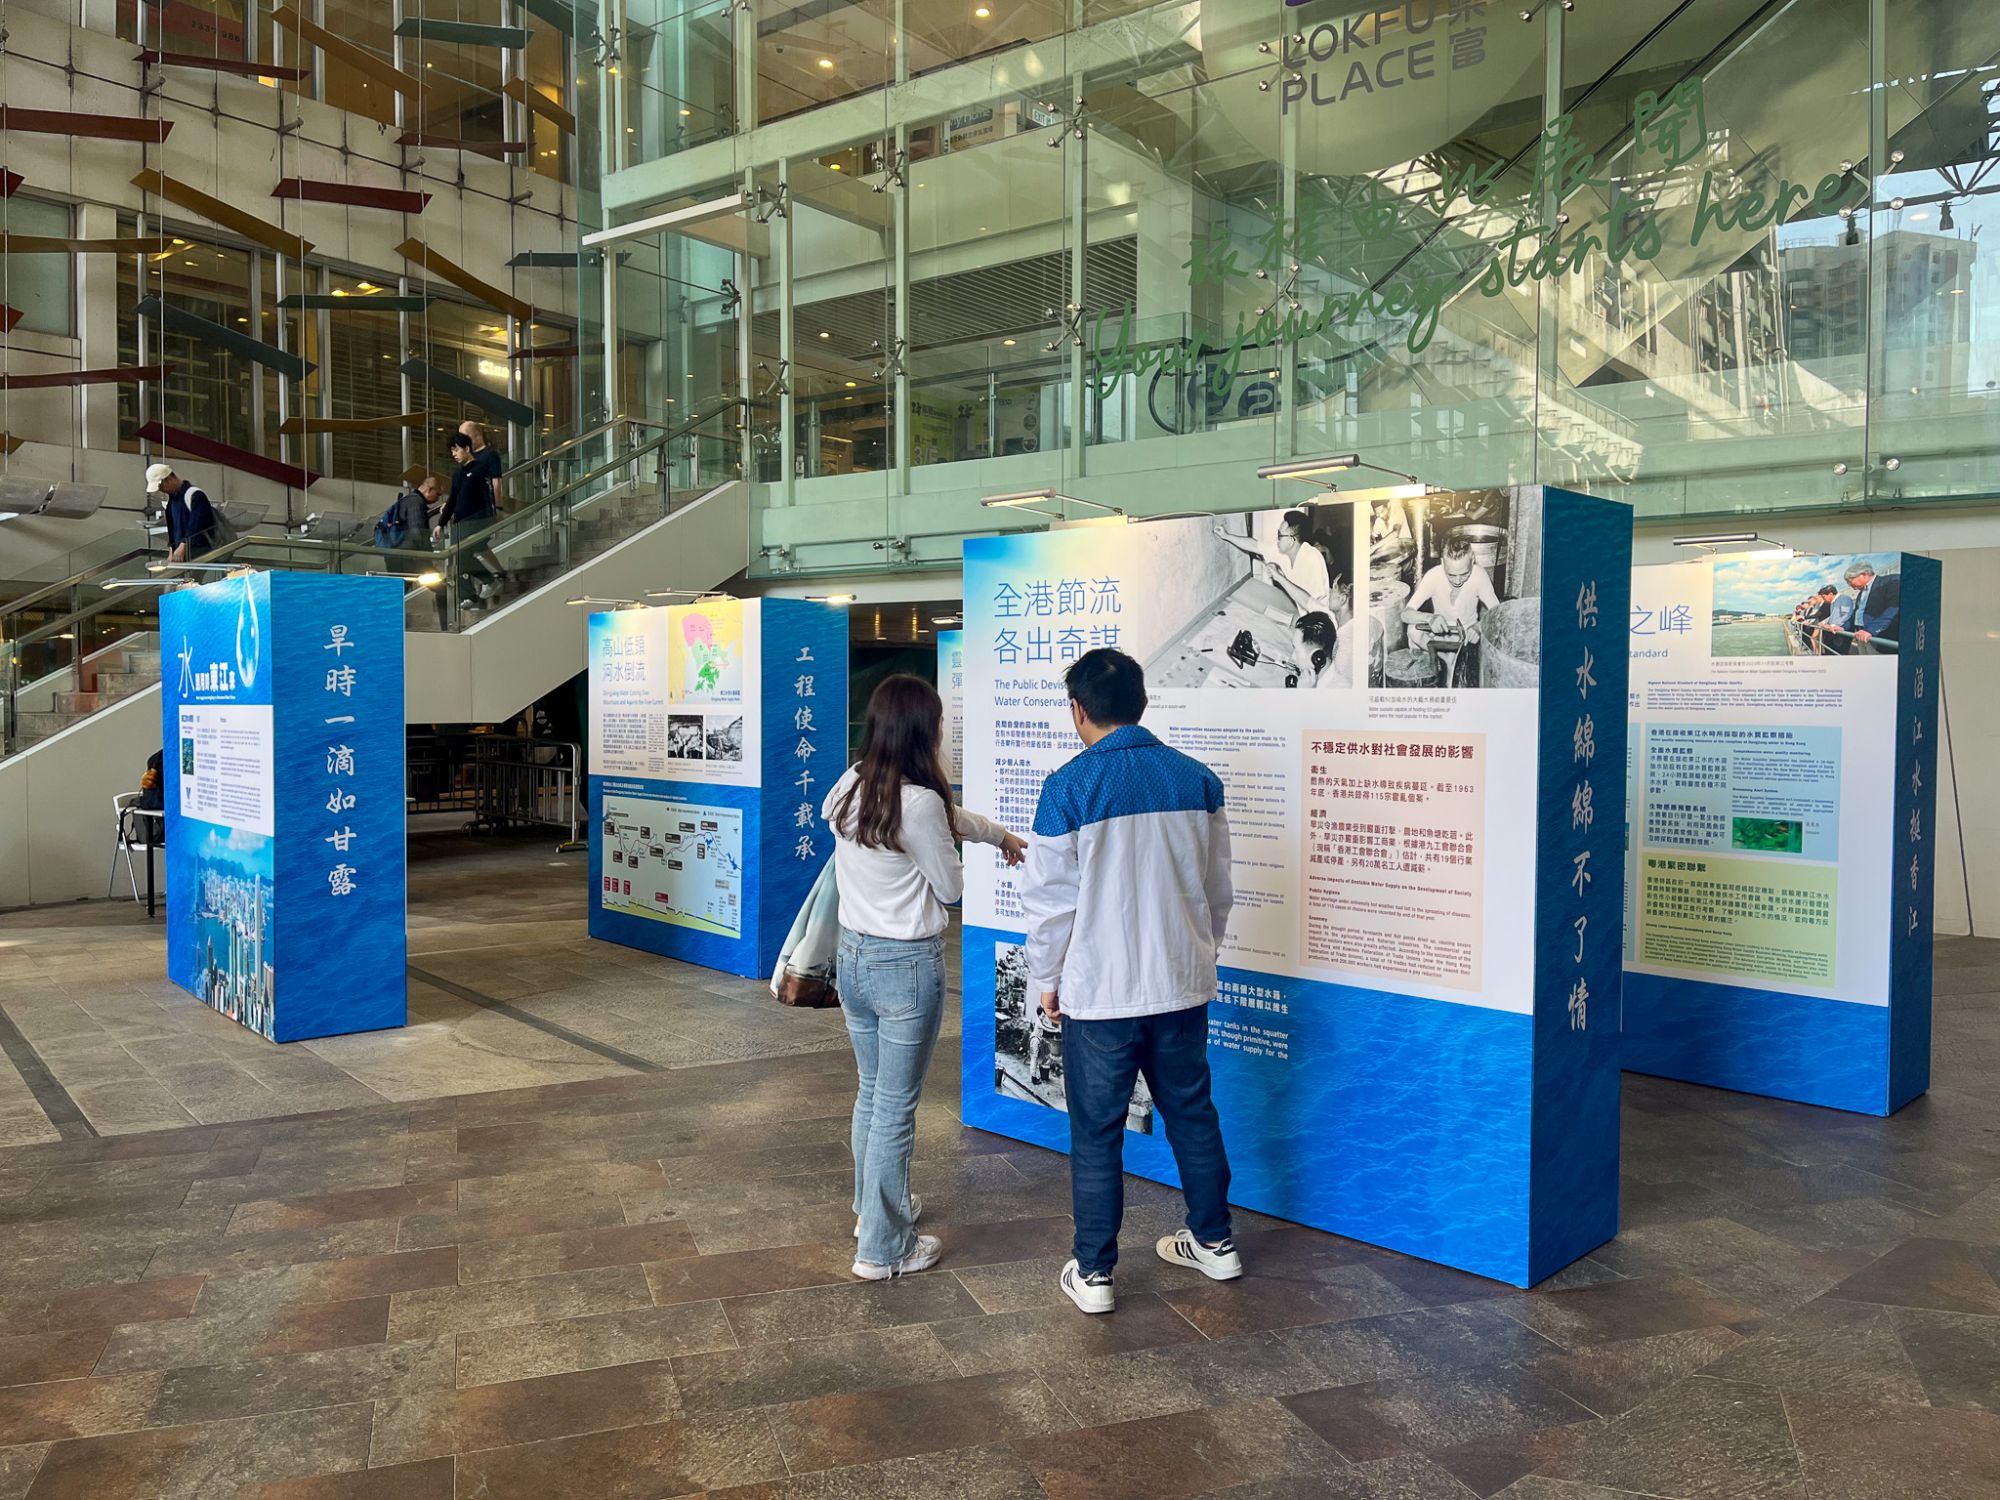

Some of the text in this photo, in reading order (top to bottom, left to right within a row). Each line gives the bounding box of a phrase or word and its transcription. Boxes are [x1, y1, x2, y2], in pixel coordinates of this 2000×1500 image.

[1282, 40, 1435, 115] PLACE
[1094, 170, 1844, 399] Your journey starts here
[994, 576, 1121, 617] 全港節流
[1630, 604, 1693, 635] 之峰
[994, 624, 1120, 664] 各出奇謀
[1630, 649, 1668, 658] tandard
[996, 680, 1010, 690] The
[1013, 680, 1038, 690] Public
[994, 697, 1020, 706] Water
[323, 624, 357, 896] 旱時一滴如甘露
[794, 647, 816, 861] 工程使命千載承
[1312, 742, 1474, 759] 不穩定供水對社會發展的影響
[1310, 809, 1326, 818] 經濟
[1568, 582, 1598, 1031] 供水綿綿不了情
[1210, 992, 1288, 1014] 是低下階層賴以維生
[1221, 1030, 1242, 1041] though
[1273, 1041, 1288, 1049] were
[1224, 1021, 1239, 1030] tanks
[1251, 1026, 1260, 1034] the
[1263, 1029, 1288, 1039] squatter
[1223, 1041, 1240, 1049] water
[1243, 1046, 1262, 1056] supply
[1266, 1048, 1274, 1056] for
[1278, 1051, 1288, 1060] the
